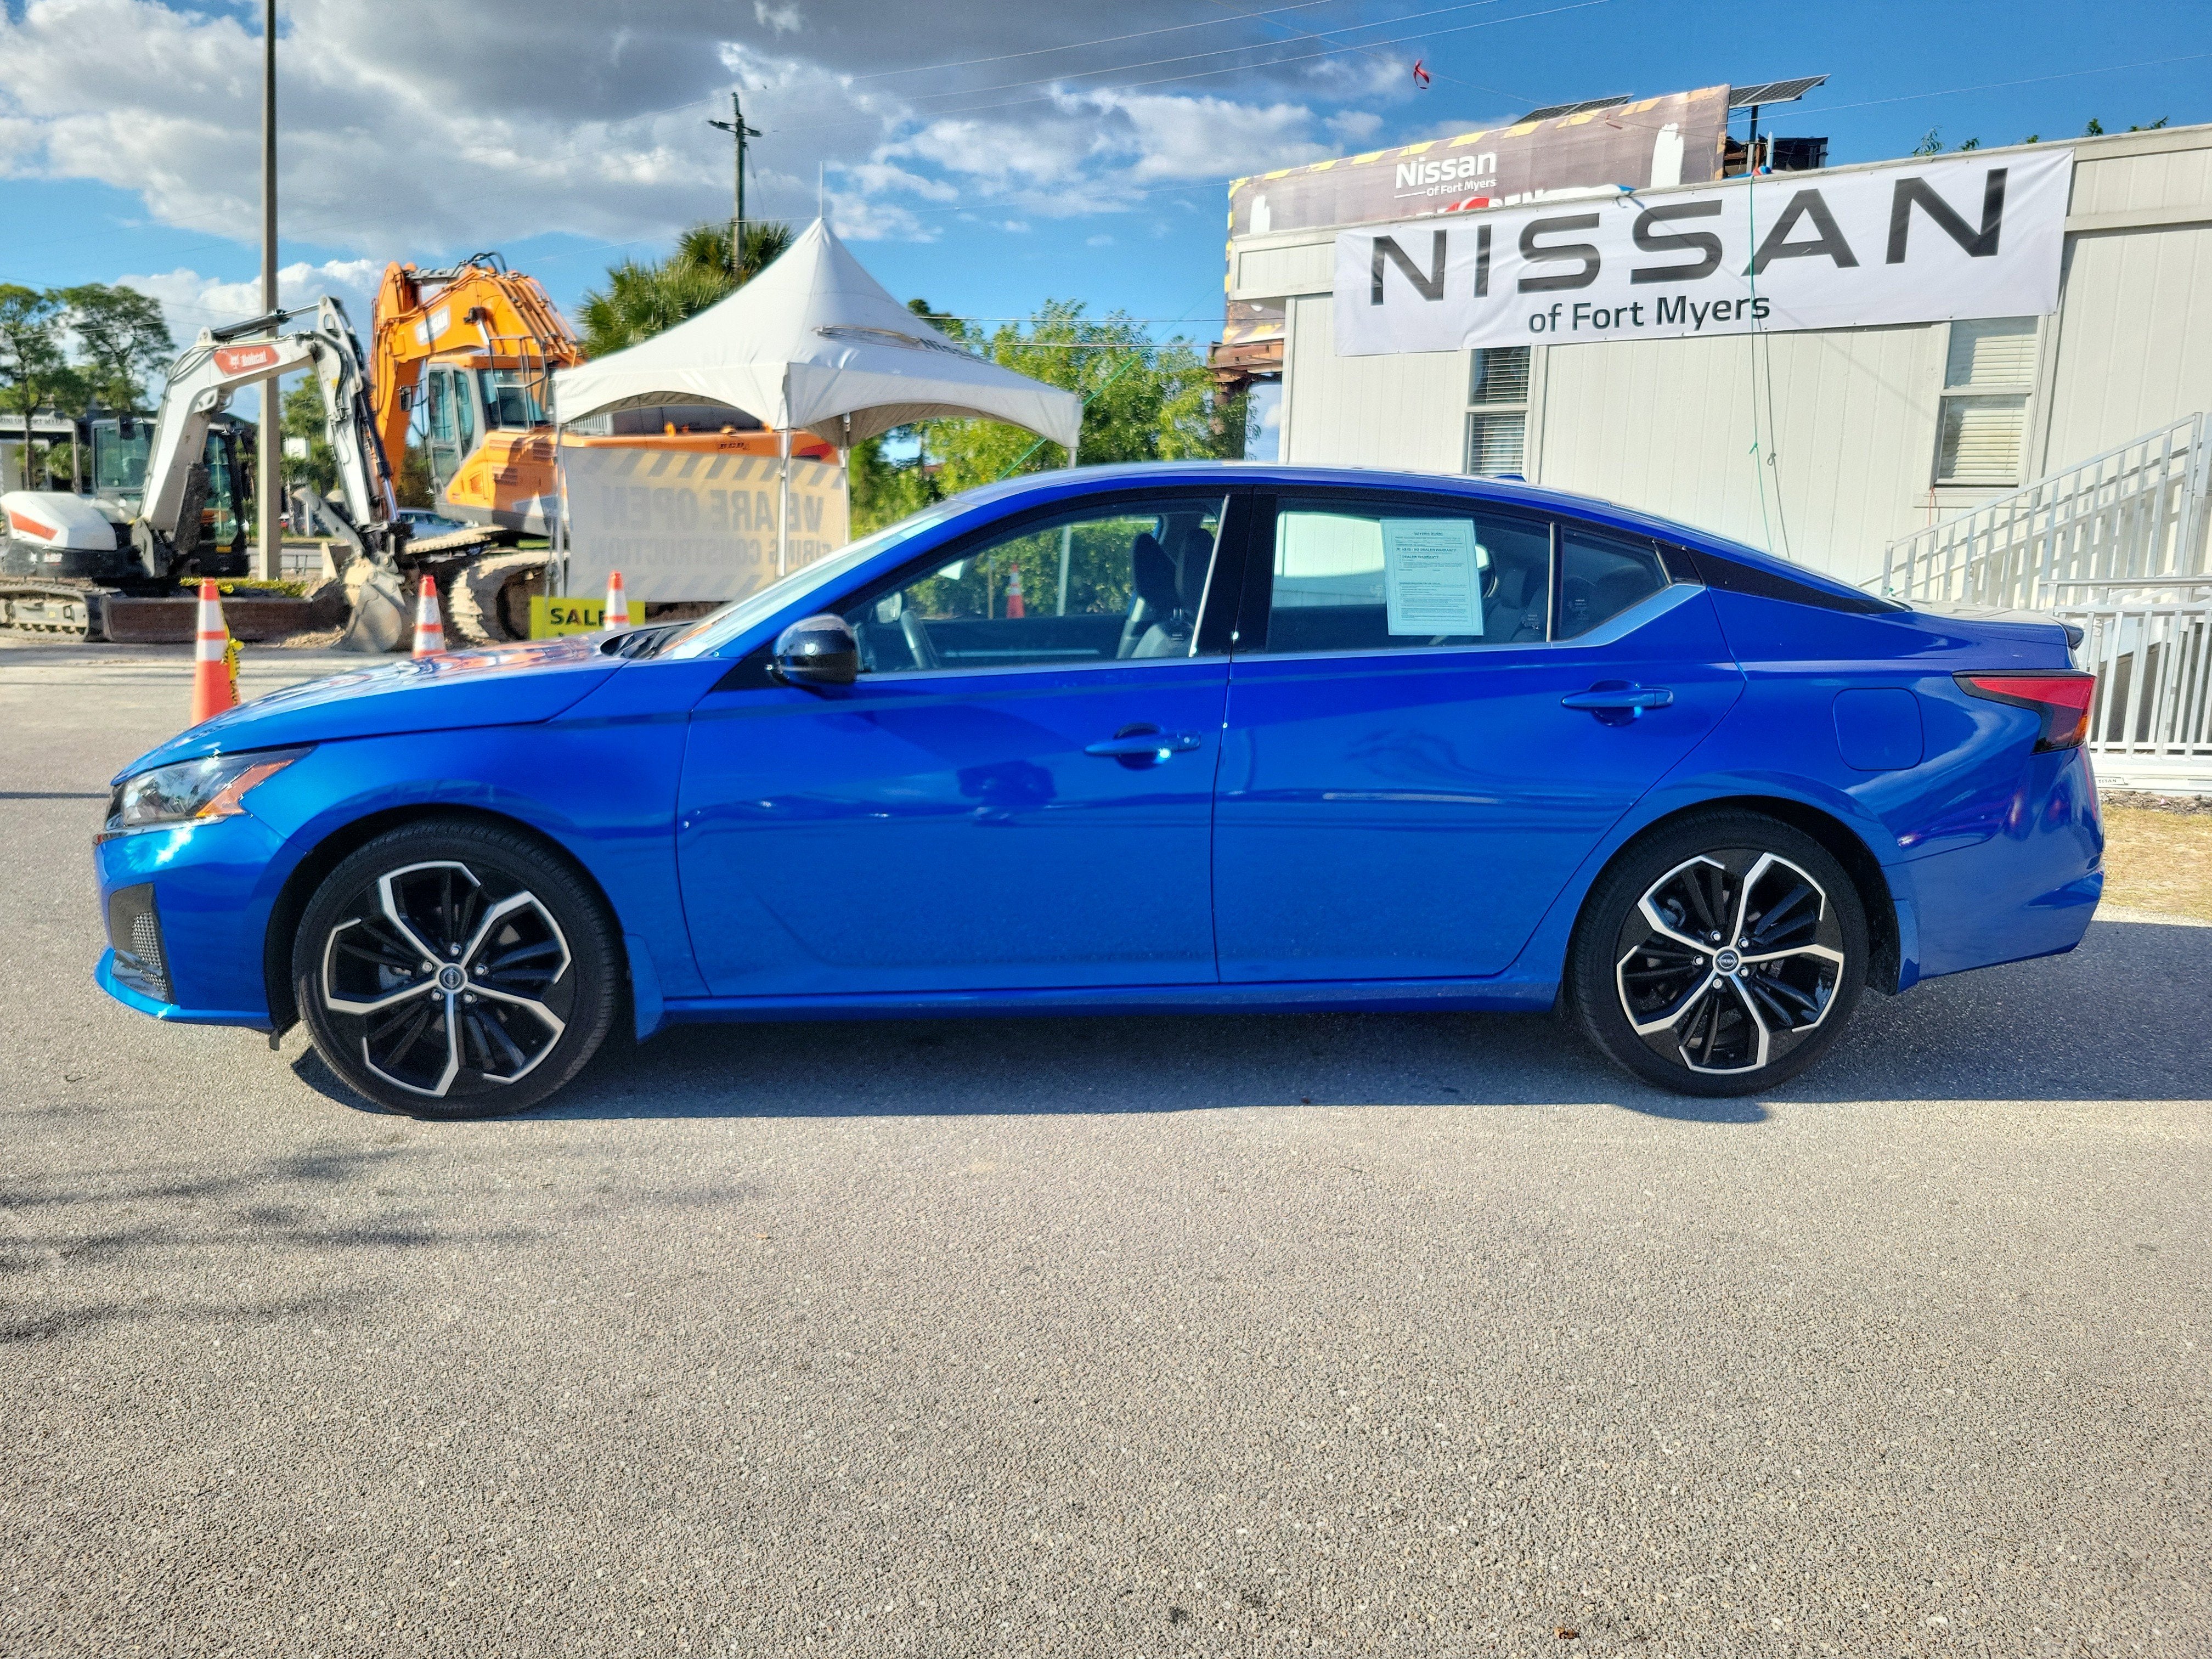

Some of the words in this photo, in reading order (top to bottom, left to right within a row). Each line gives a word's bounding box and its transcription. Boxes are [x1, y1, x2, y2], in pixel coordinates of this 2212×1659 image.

[1395, 152, 1497, 189] Nissan
[1440, 184, 1463, 195] Fort
[1464, 178, 1497, 192] Myers
[1370, 167, 2008, 306] NISSAN
[1528, 303, 1562, 334] of
[1572, 301, 1644, 331] Fort
[1656, 295, 1770, 332] Myers
[241, 351, 267, 368] Bobcat
